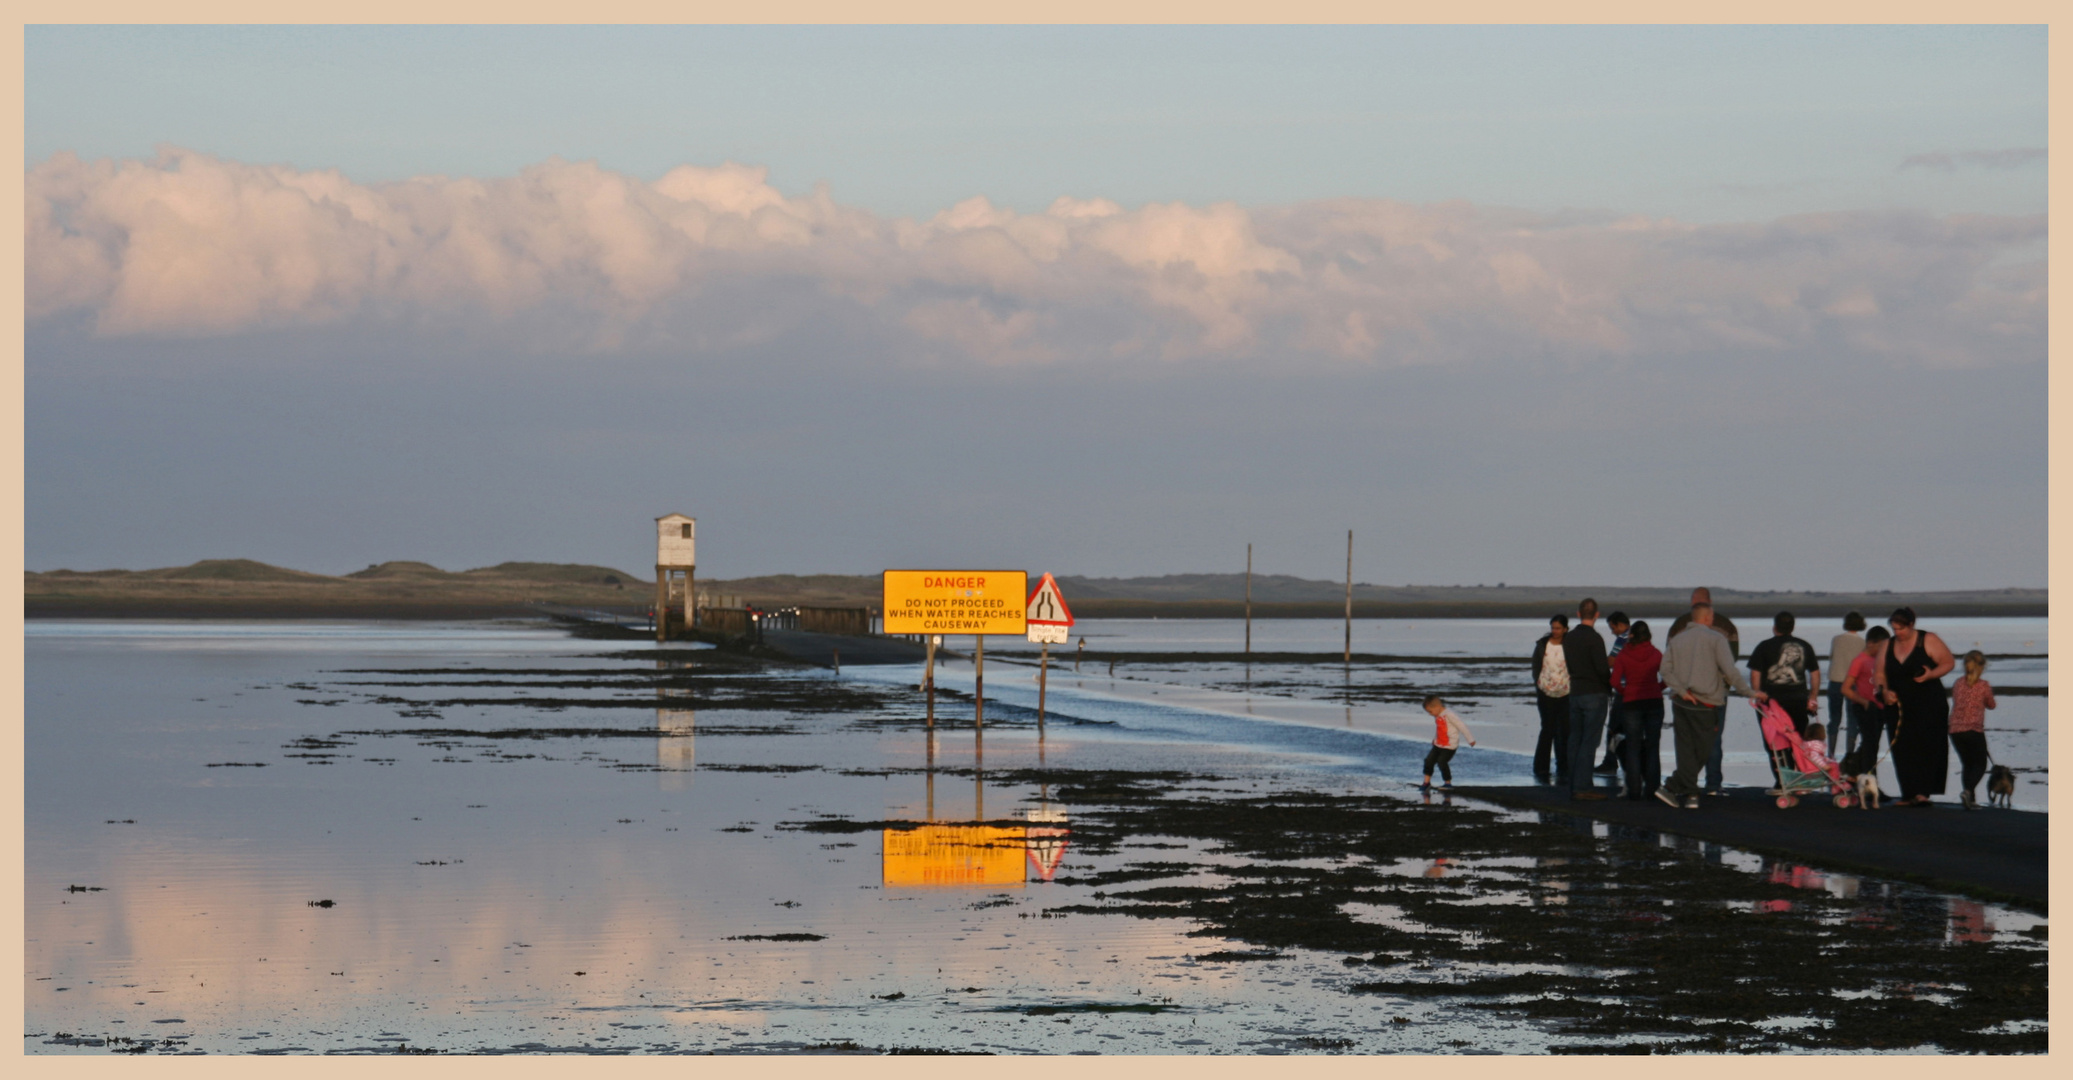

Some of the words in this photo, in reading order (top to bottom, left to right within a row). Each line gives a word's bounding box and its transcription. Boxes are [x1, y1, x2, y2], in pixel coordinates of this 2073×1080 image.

[924, 577, 986, 588] DANGER
[905, 599, 921, 608] DO
[925, 599, 948, 608] NOT
[951, 599, 1004, 608] PROCEED
[889, 610, 923, 618] WHEN
[926, 610, 965, 618] WATER
[968, 610, 1022, 619] REACHES
[924, 620, 987, 629] CAUSEWAY
